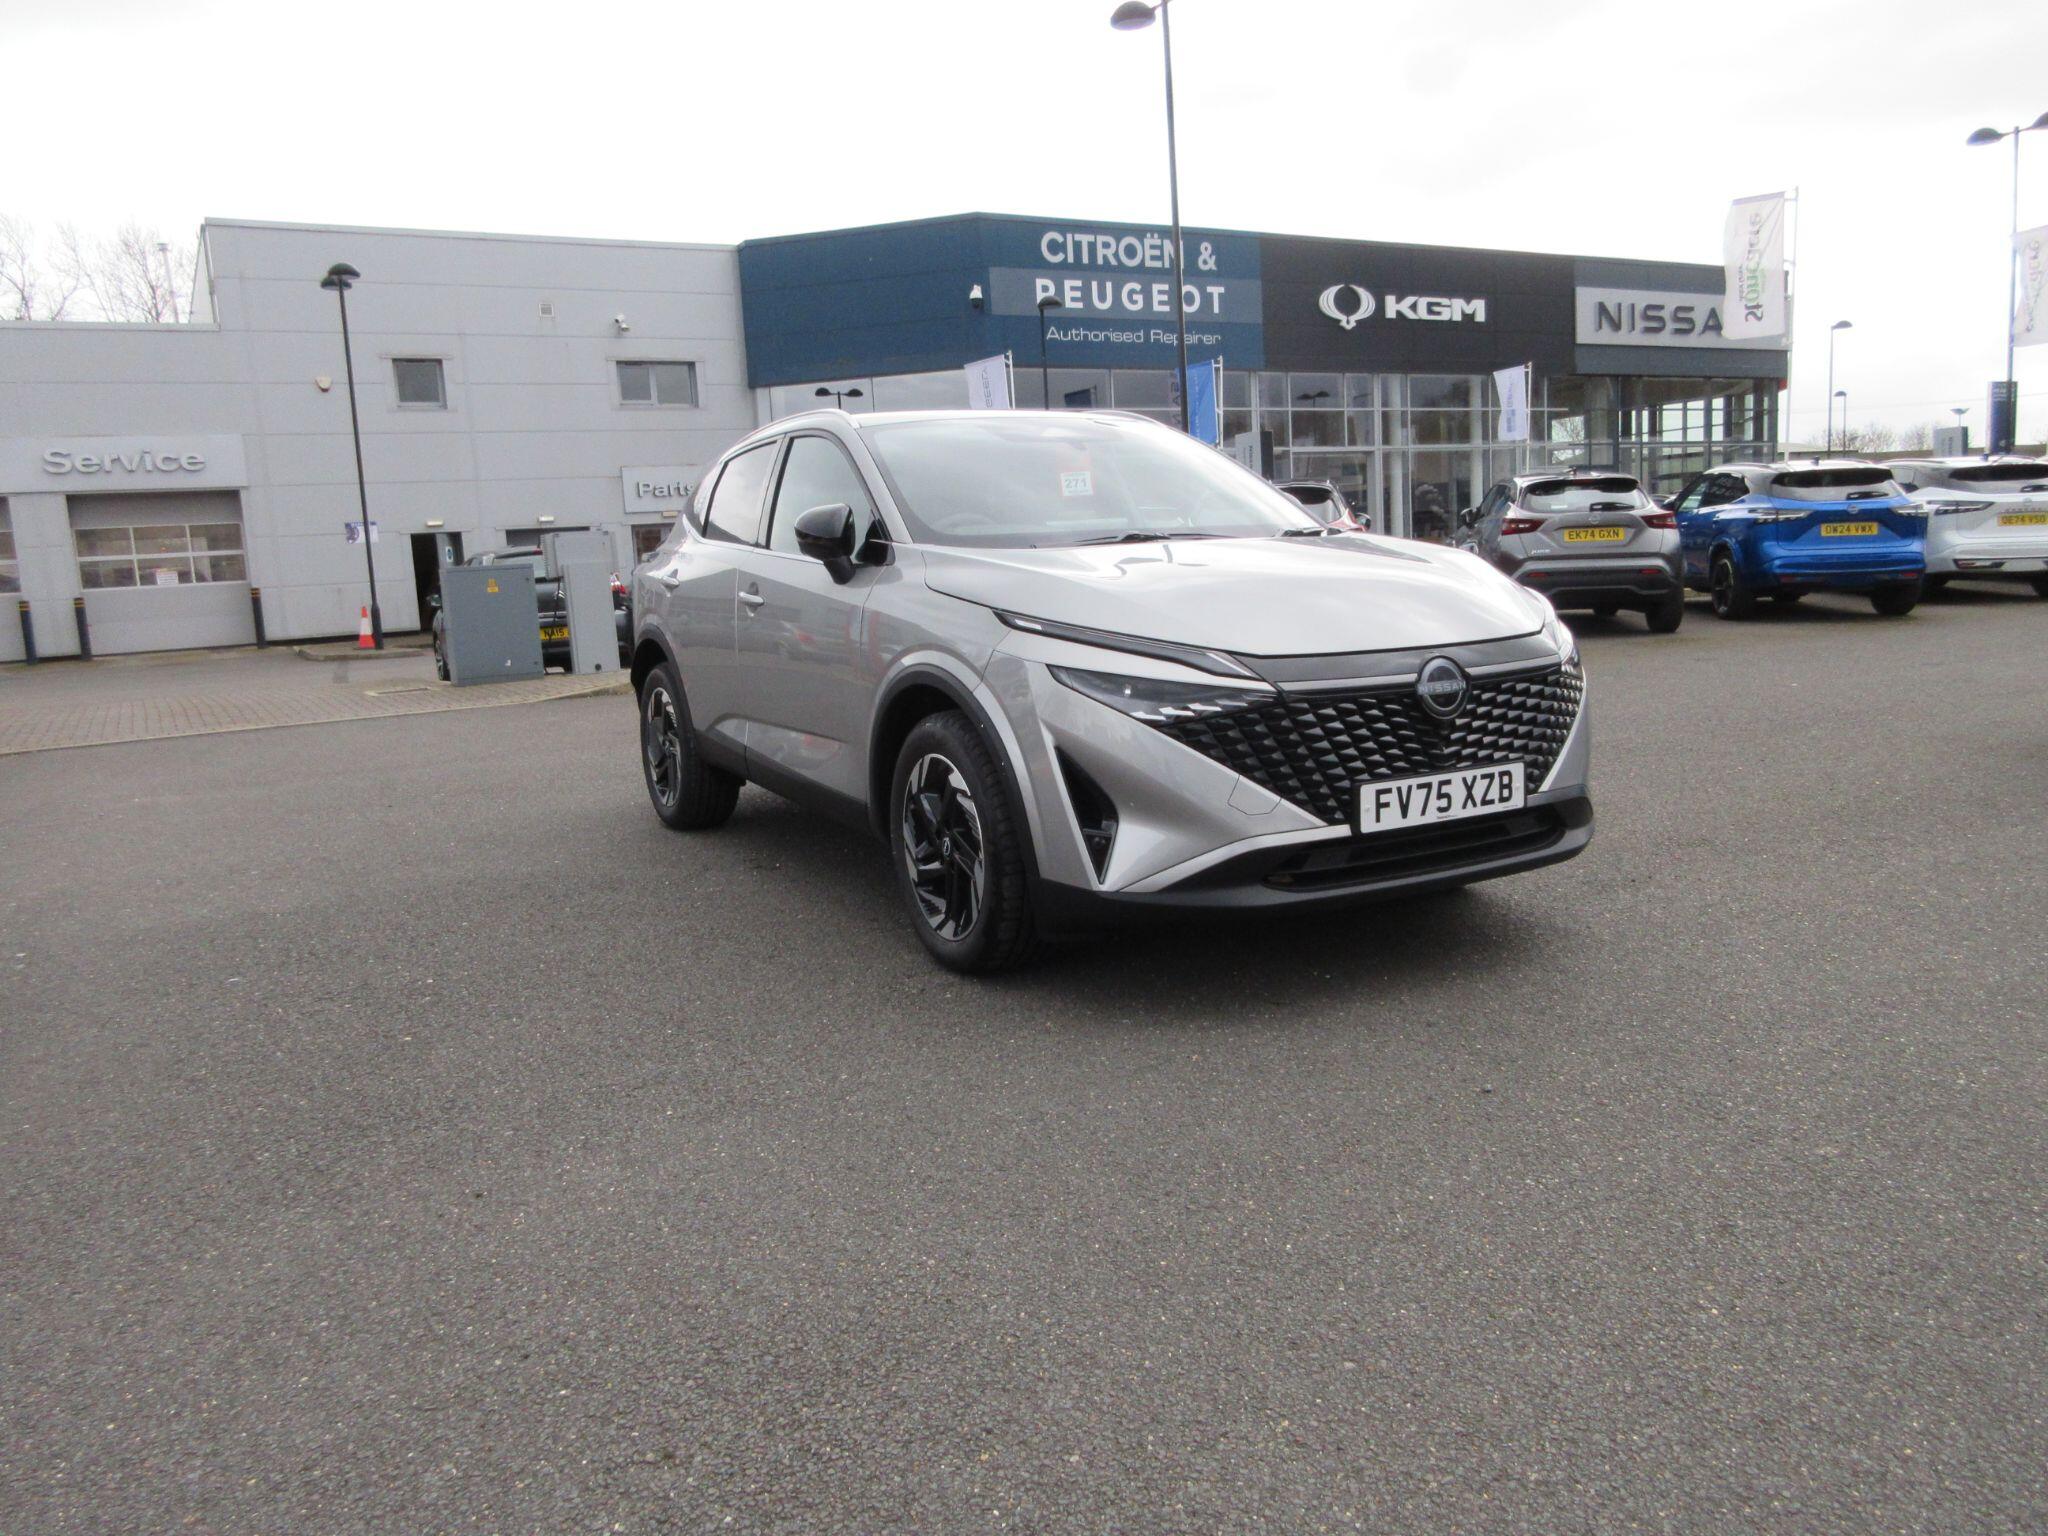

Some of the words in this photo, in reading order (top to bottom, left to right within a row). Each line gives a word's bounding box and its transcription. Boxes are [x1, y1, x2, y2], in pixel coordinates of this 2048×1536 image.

[1040, 231, 1184, 270] CITROËN
[1197, 241, 1217, 271] &
[1035, 277, 1225, 314] PEUGEOT
[1384, 295, 1486, 323] KGM
[1046, 325, 1144, 343] Authorised
[1150, 329, 1221, 346] Repairer
[43, 449, 206, 475] Service
[1568, 529, 1596, 540] EK74
[1598, 528, 1620, 539] GXN
[1419, 680, 1466, 694] NISSAN
[1375, 779, 1453, 824] FV75
[1461, 769, 1513, 810] XZB
